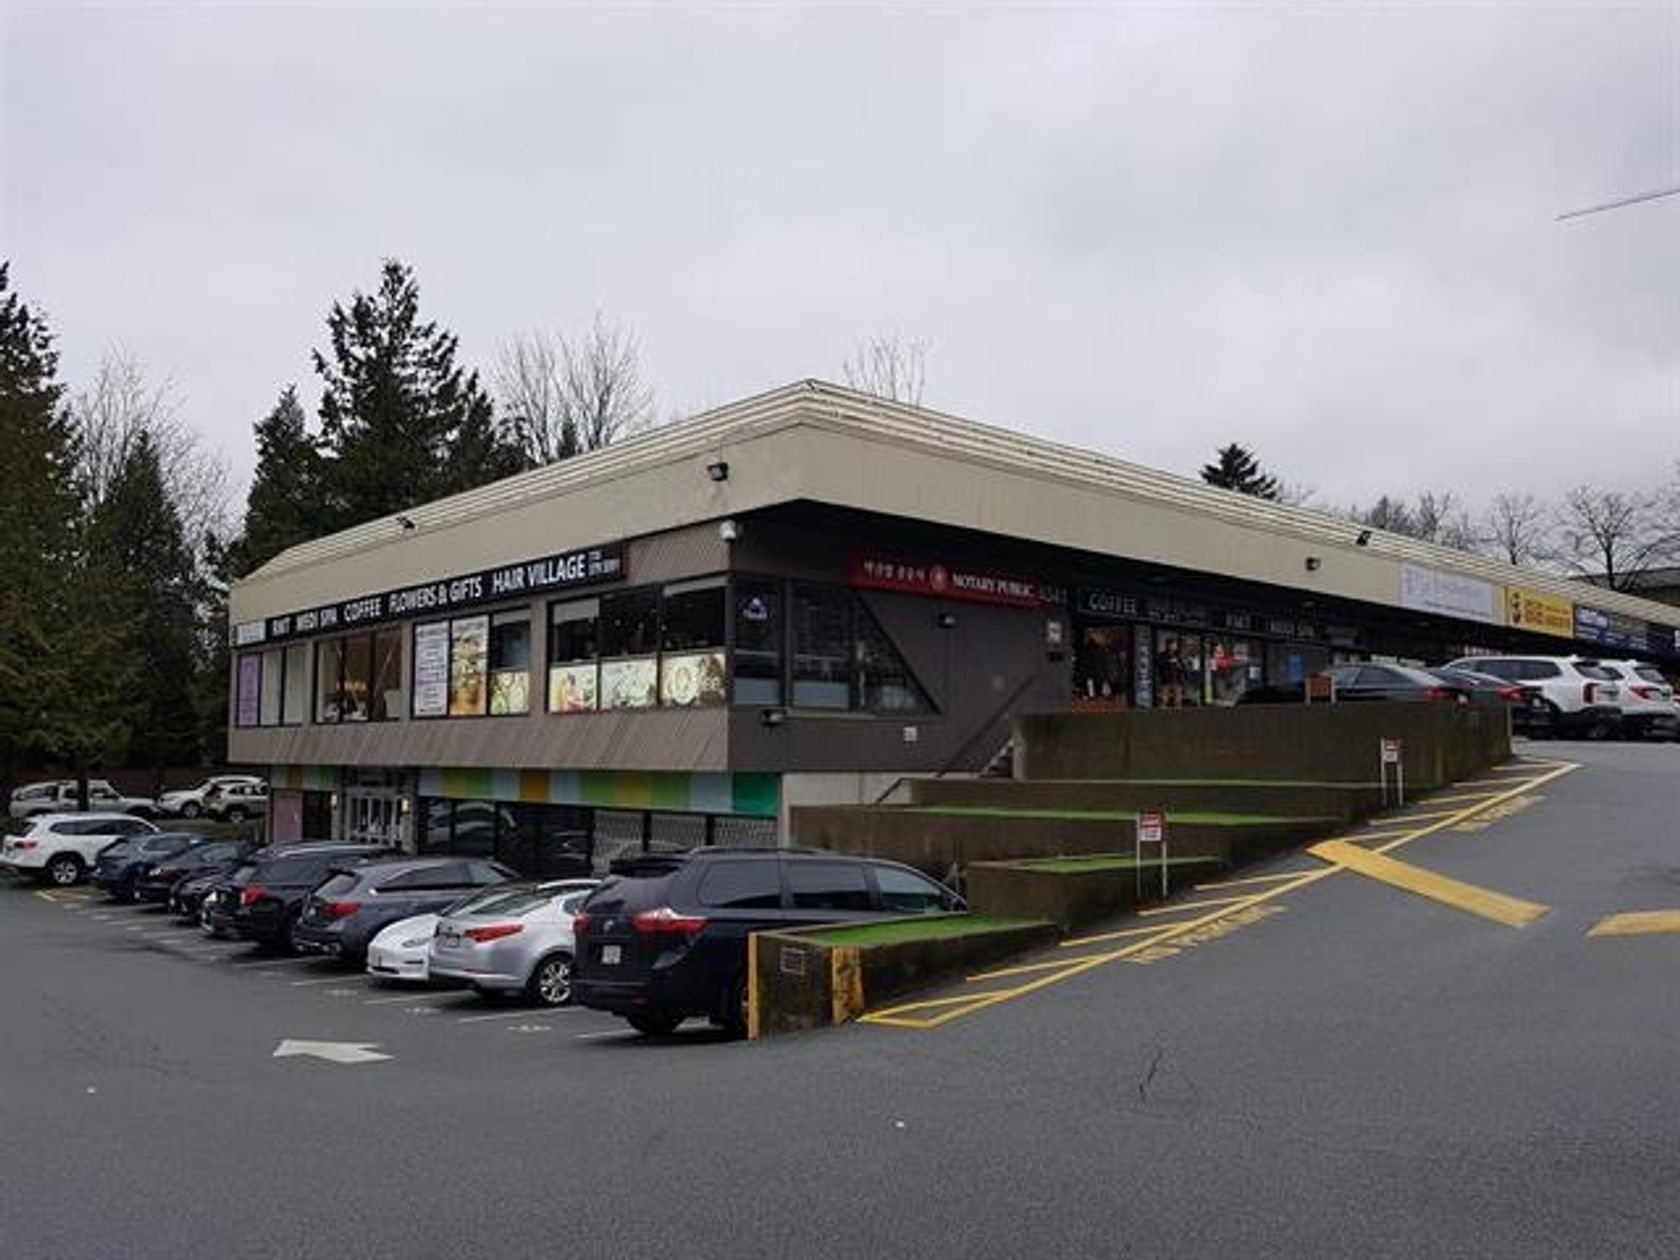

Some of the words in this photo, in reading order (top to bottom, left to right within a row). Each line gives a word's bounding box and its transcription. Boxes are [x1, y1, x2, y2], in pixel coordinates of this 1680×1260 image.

[492, 567, 525, 593] HAIR
[528, 553, 585, 587] VILLAGE
[953, 573, 994, 592] NOTARY
[996, 580, 1036, 597] PUBLIC
[388, 585, 437, 613] FLOWERS
[438, 583, 448, 605] &
[449, 576, 482, 602] GIFTS
[1089, 593, 1137, 615] COFFEE
[344, 597, 382, 622] COFFEE
